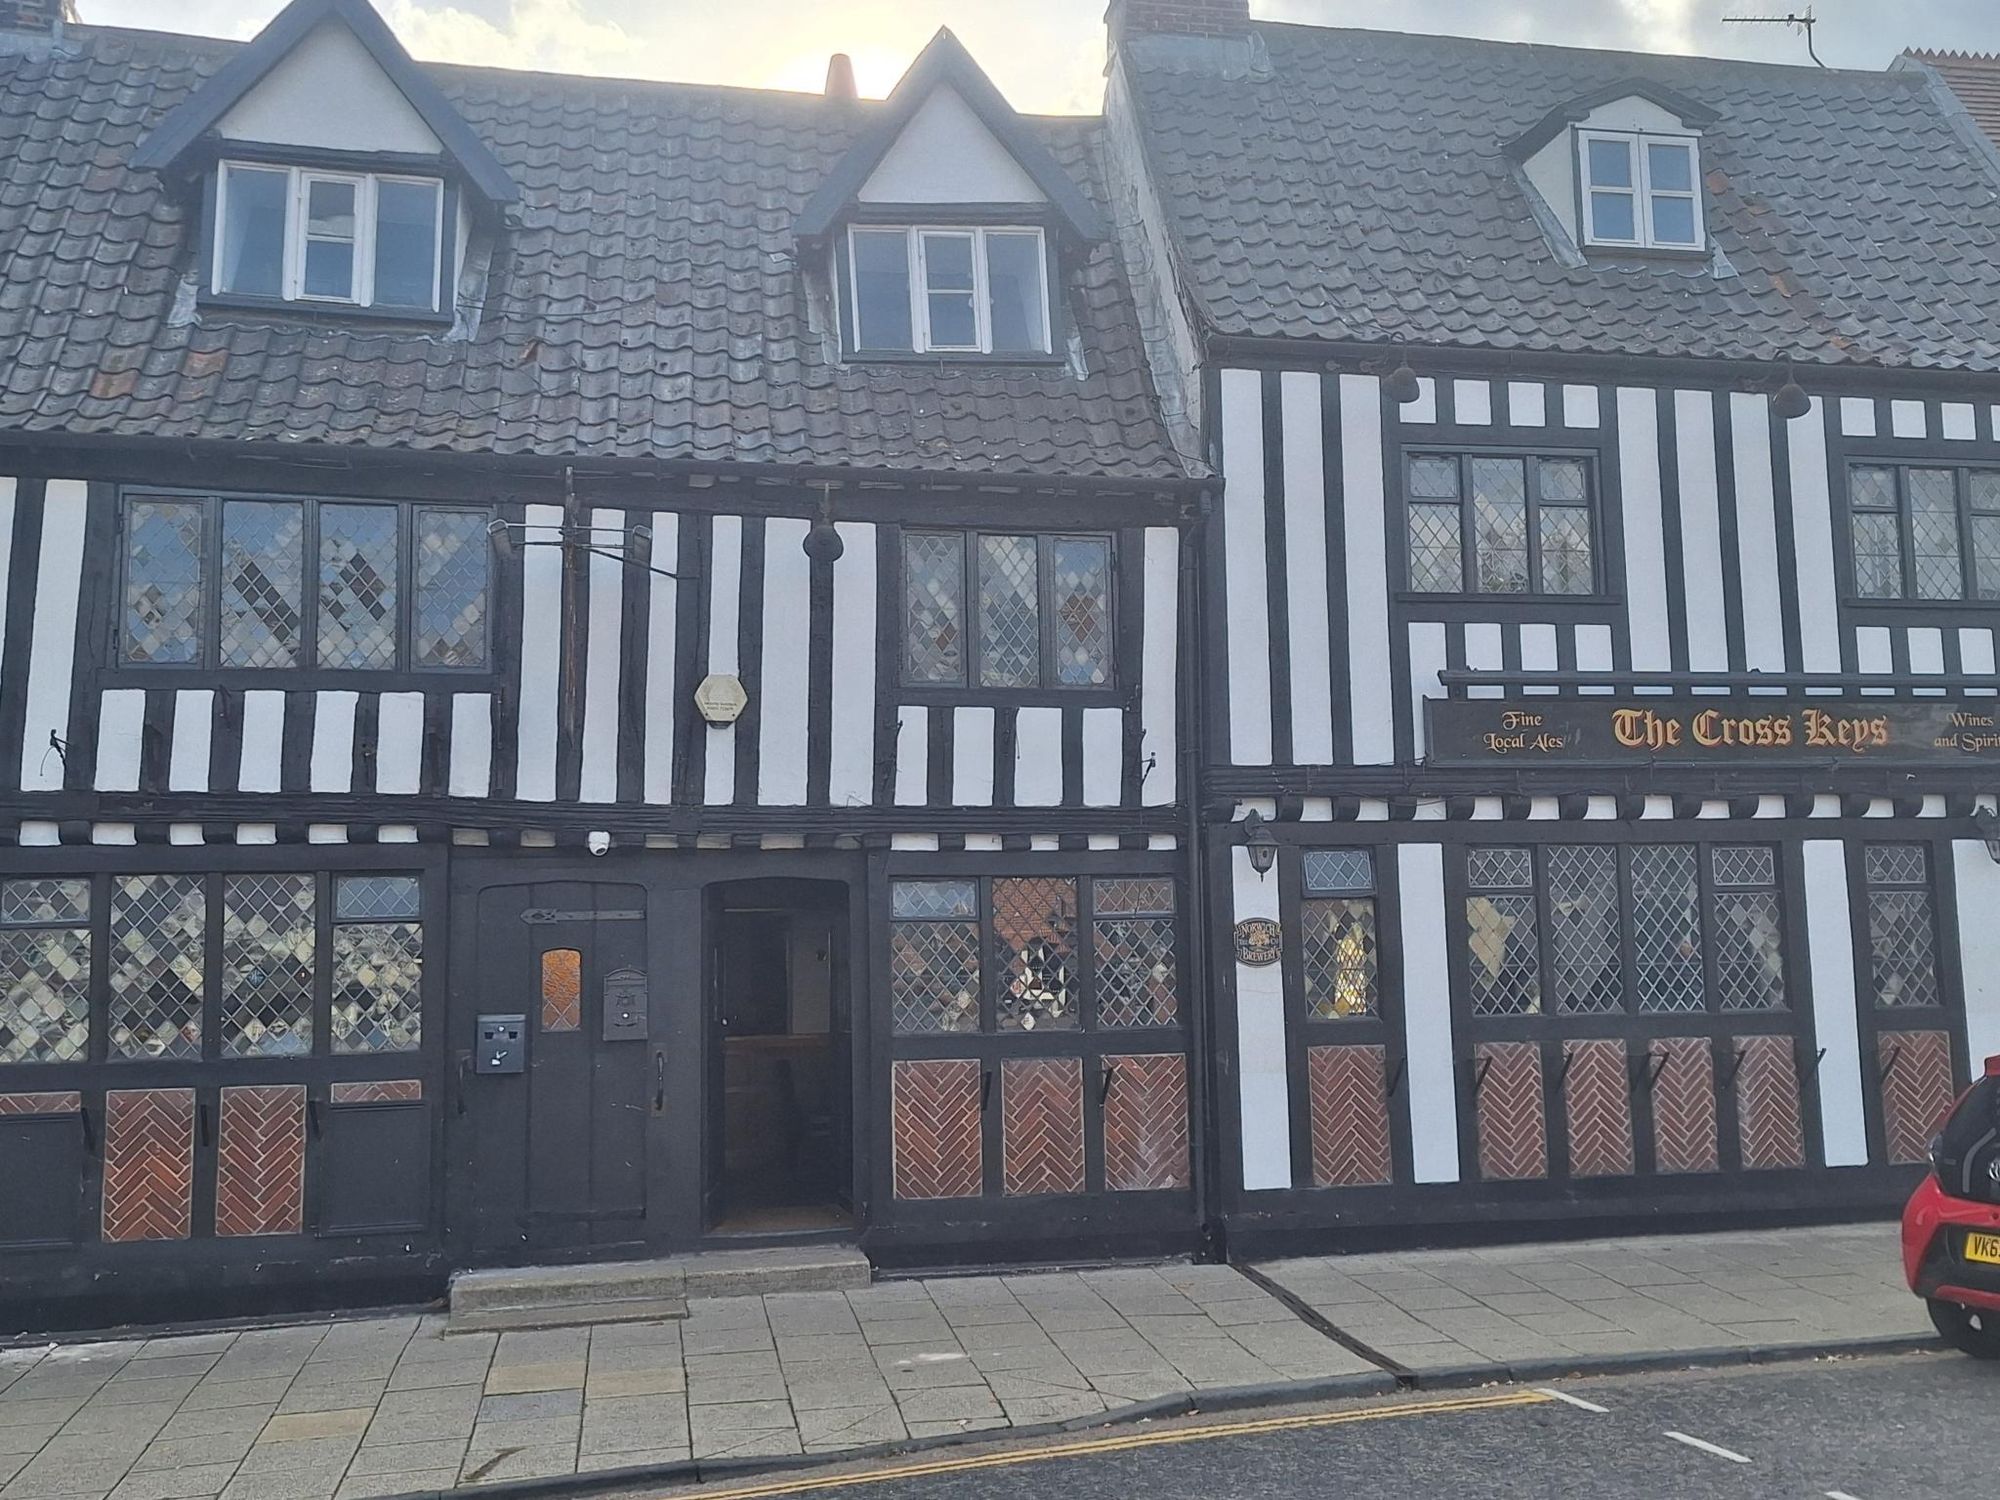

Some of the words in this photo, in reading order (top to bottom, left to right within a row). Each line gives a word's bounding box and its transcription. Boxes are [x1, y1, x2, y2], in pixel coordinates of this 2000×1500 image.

[1502, 711, 1542, 730] Fine
[1946, 712, 1994, 727] Wines
[1612, 708, 1682, 751] The
[1692, 708, 1795, 748] Cross
[1801, 708, 1889, 752] Keys
[1483, 732, 1525, 754] Local
[1529, 733, 1565, 752] Ales
[1934, 732, 1959, 747] and
[1240, 921, 1276, 938] NORWICH
[1242, 946, 1277, 961] BREWERY
[1974, 1235, 2000, 1257] VK6
